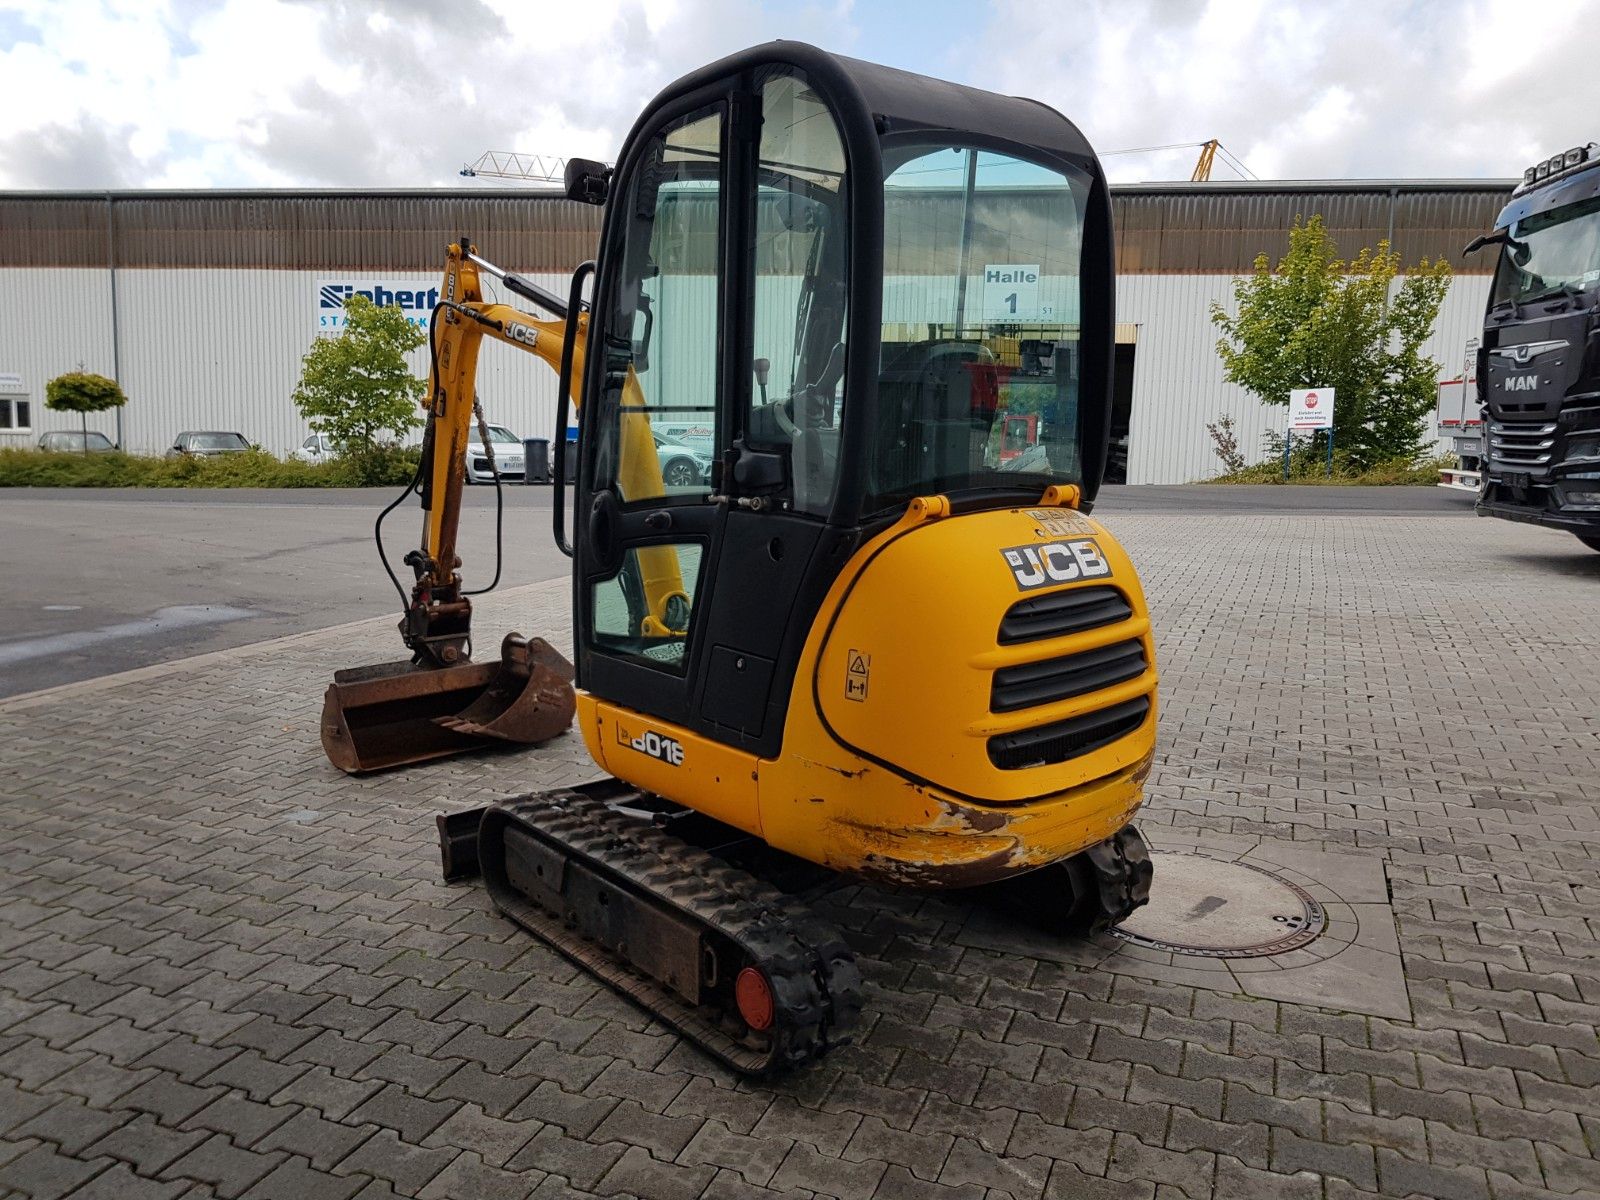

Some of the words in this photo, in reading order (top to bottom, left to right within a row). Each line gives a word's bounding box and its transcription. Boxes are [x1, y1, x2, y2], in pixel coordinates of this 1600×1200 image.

[986, 271, 1037, 283] Halle
[1004, 293, 1017, 314] 1
[506, 321, 538, 346] JCB
[1505, 375, 1538, 391] MAN
[1004, 541, 1109, 586] JCB
